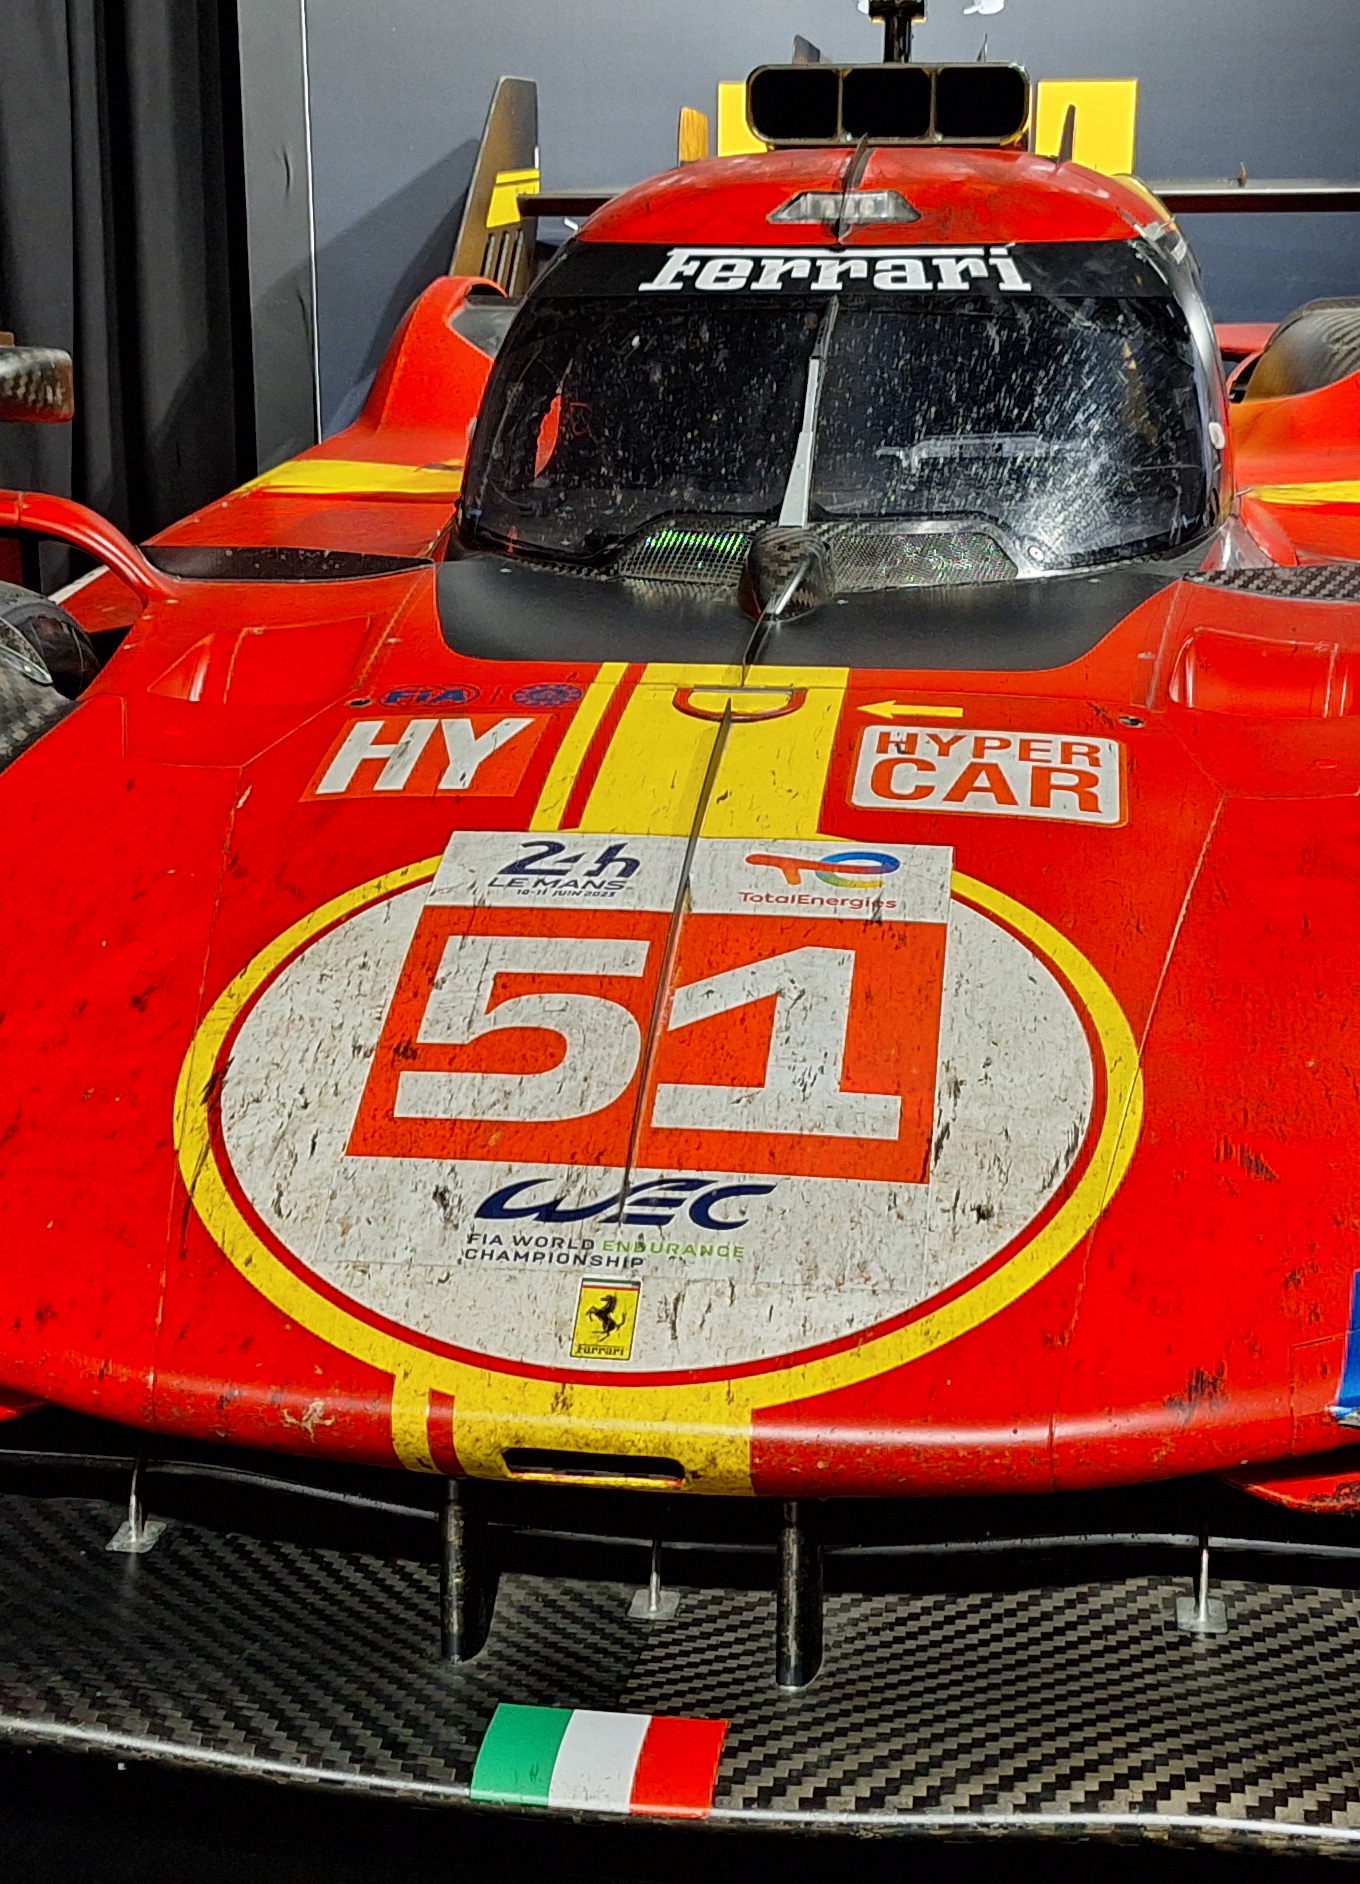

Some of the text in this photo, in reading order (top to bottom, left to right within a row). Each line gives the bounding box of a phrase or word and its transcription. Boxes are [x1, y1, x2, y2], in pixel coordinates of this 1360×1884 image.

[639, 242, 1032, 292] Ferrari
[384, 688, 468, 705] FIA
[314, 717, 537, 795] HY
[875, 731, 1103, 768] HYPER
[870, 757, 1103, 814] CAR
[487, 877, 628, 891] LE MANS
[740, 891, 898, 910] TotalEnergies
[393, 934, 902, 1141] 51
[474, 1177, 778, 1231] WEC
[464, 1248, 645, 1269] CHAMPIONSHIP
[466, 1233, 745, 1259] FIA WORLD ENDURANCE
